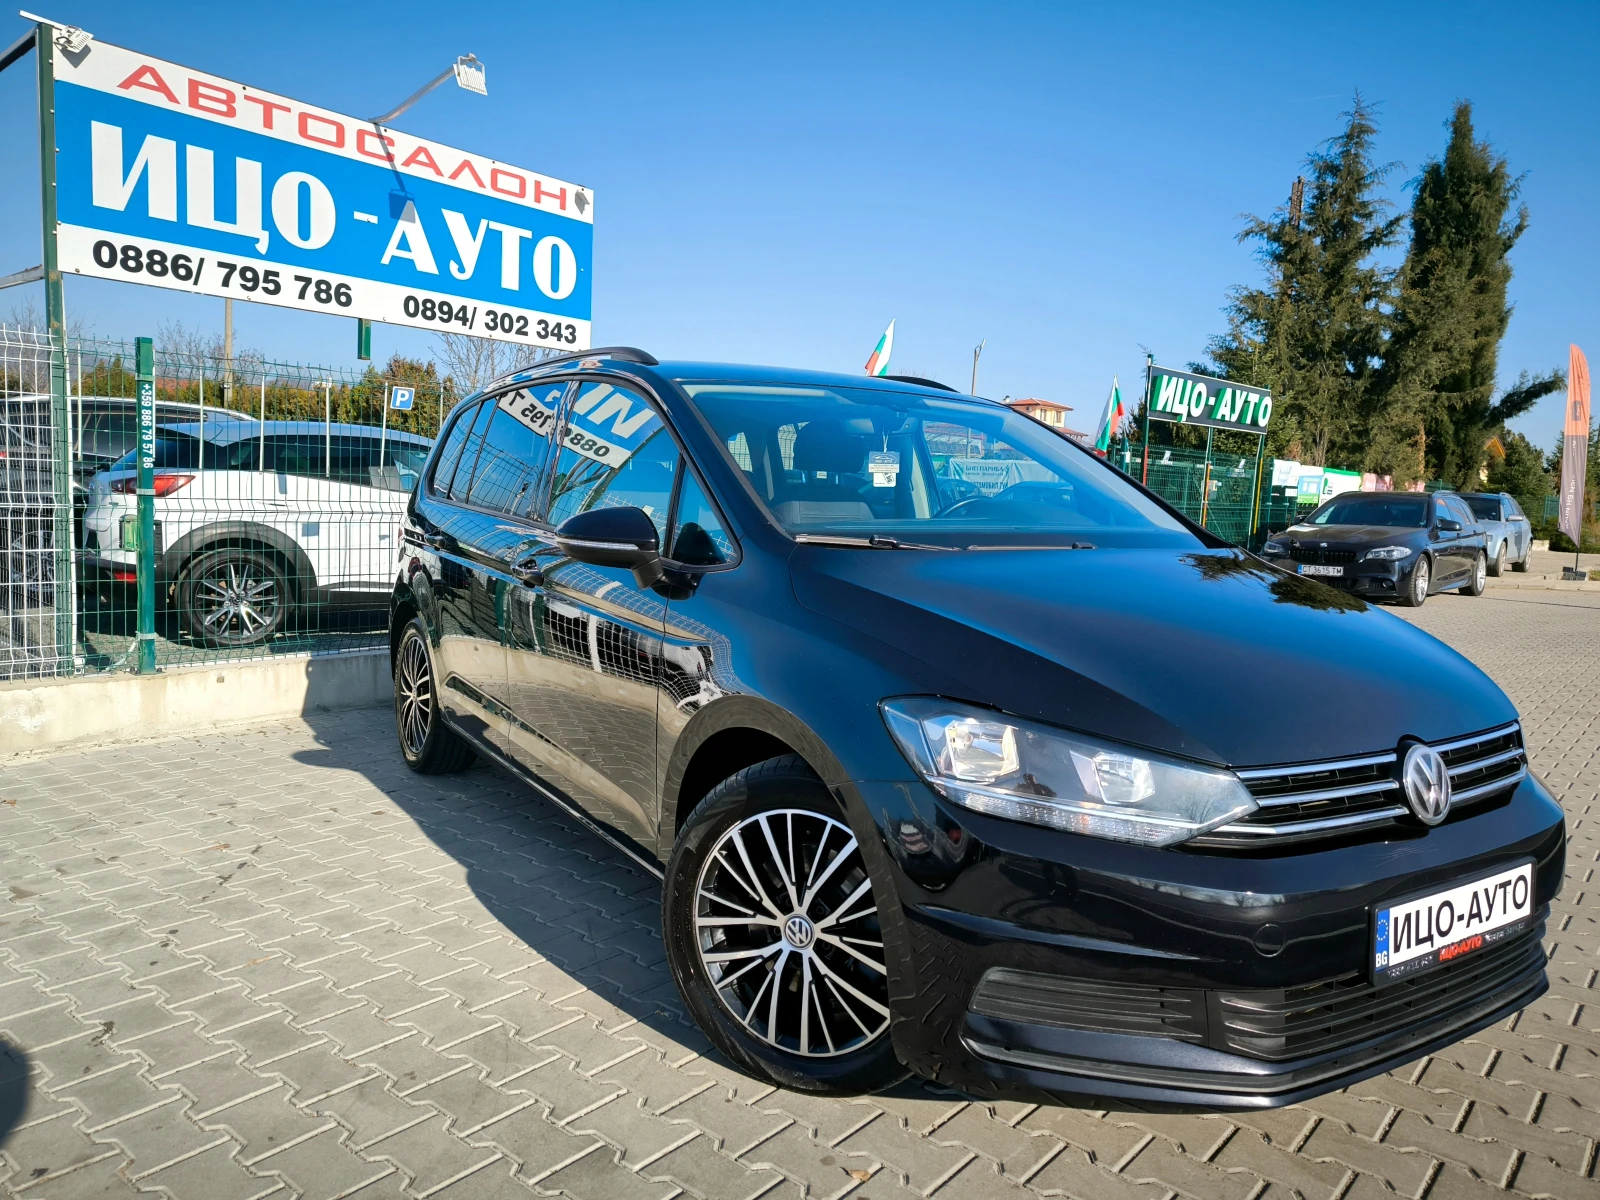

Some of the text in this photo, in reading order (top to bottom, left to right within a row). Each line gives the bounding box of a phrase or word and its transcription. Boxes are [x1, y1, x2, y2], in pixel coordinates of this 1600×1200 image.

[116, 64, 567, 212] АВТОСАЛОН
[92, 239, 353, 308] 0886/ 795 786
[403, 295, 577, 344] 0894/ 302 343
[141, 383, 154, 469] +359 886 79 57 86
[1154, 374, 1273, 427] ИЦО-АУТО
[1393, 874, 1529, 954] ИЦО-АУТО
[1375, 951, 1388, 968] BG
